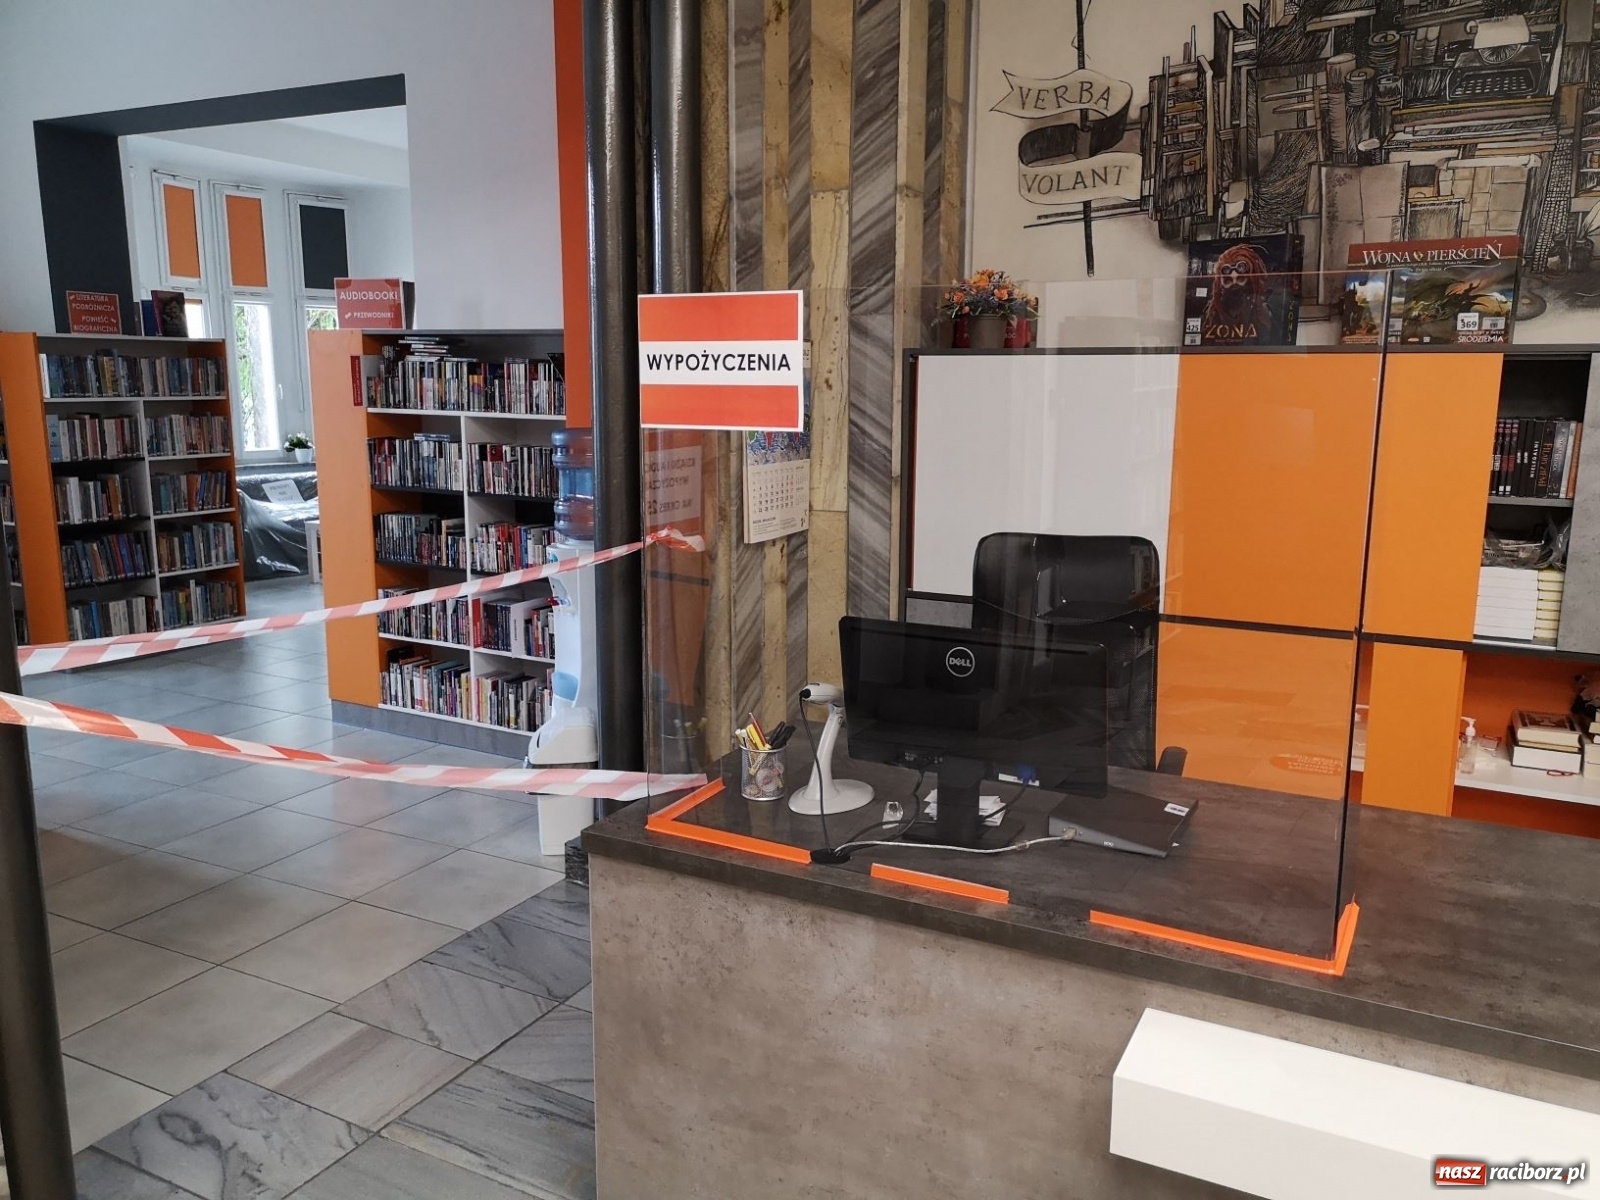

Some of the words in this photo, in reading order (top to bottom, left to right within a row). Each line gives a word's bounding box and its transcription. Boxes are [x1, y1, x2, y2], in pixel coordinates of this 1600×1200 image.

[1018, 81, 1111, 111] VERBA
[1022, 165, 1129, 195] VOLANT
[1363, 250, 1411, 266] WOJNA
[1427, 240, 1502, 262] PIERŚCIEŃ
[76, 294, 109, 302] LITERATURA
[340, 291, 398, 300] AUDIOBOOKI
[1205, 324, 1258, 339] ZONA
[1460, 320, 1477, 329] 369
[646, 349, 791, 371] WYPOŻYCZENIA
[1530, 441, 1540, 478] NIELEGALNI
[949, 657, 972, 667] DELL
